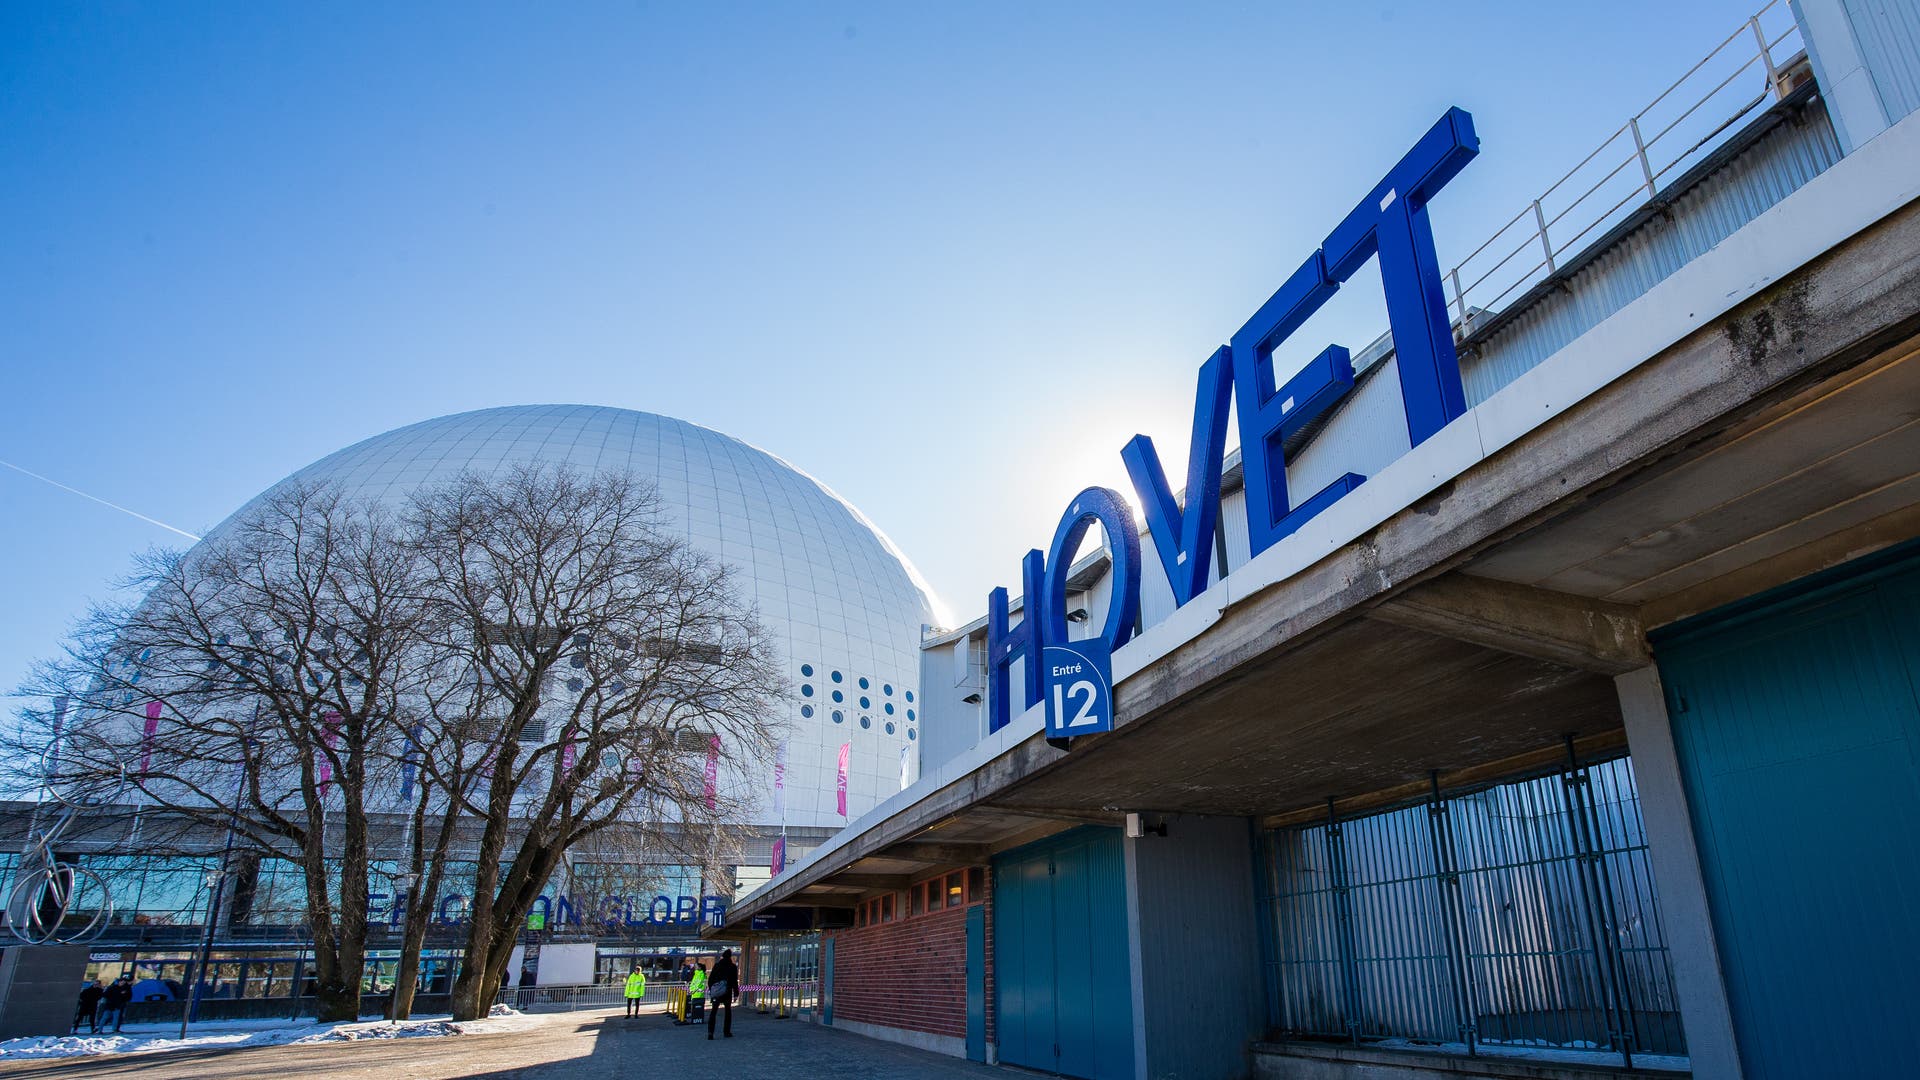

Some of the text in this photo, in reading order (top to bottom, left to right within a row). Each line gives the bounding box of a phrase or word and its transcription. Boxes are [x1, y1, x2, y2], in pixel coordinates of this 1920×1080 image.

[988, 105, 1480, 735] HOVET
[1052, 662, 1082, 677] Entré
[1053, 680, 1098, 730] 12
